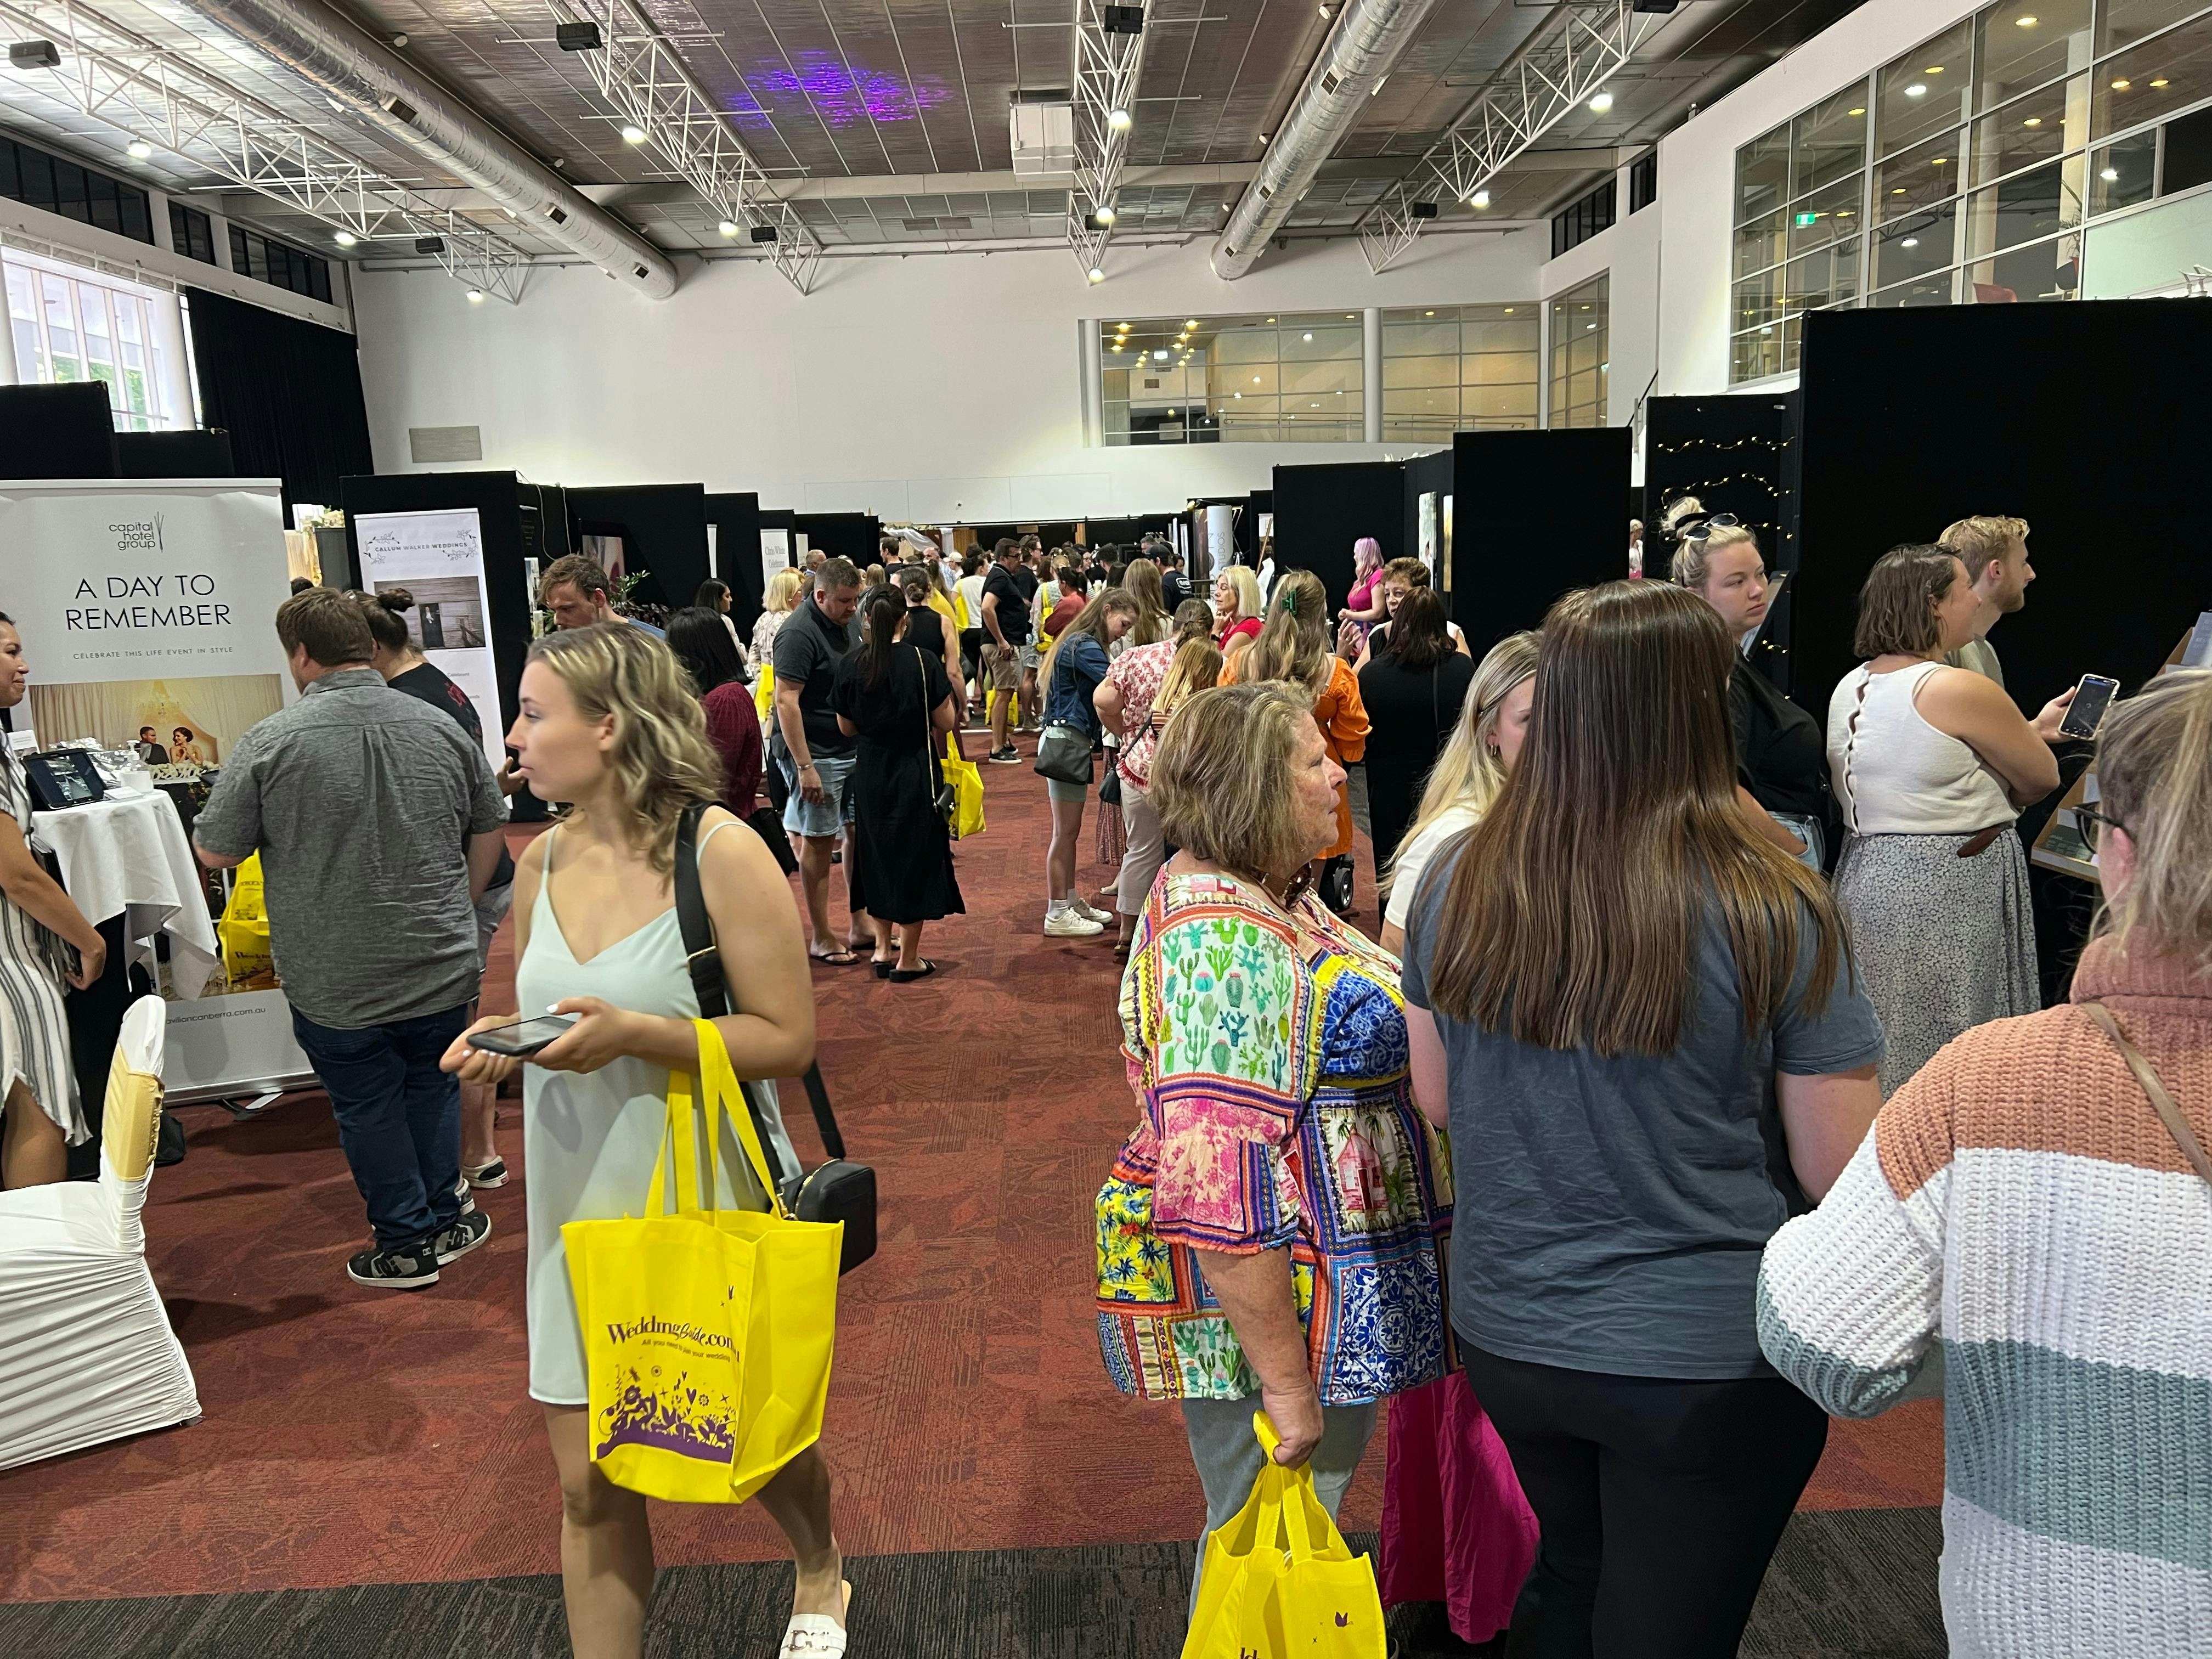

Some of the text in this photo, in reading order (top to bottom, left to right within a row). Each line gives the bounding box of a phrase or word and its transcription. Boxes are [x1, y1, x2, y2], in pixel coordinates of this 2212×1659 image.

[109, 521, 153, 533] capital
[123, 531, 154, 540] hotel
[117, 540, 156, 551] group
[75, 574, 215, 599] A DAY TO
[66, 604, 232, 630] REMEMBER
[73, 651, 121, 659] CELEBRATE
[165, 1008, 266, 1025] avilioncanberra.com.au
